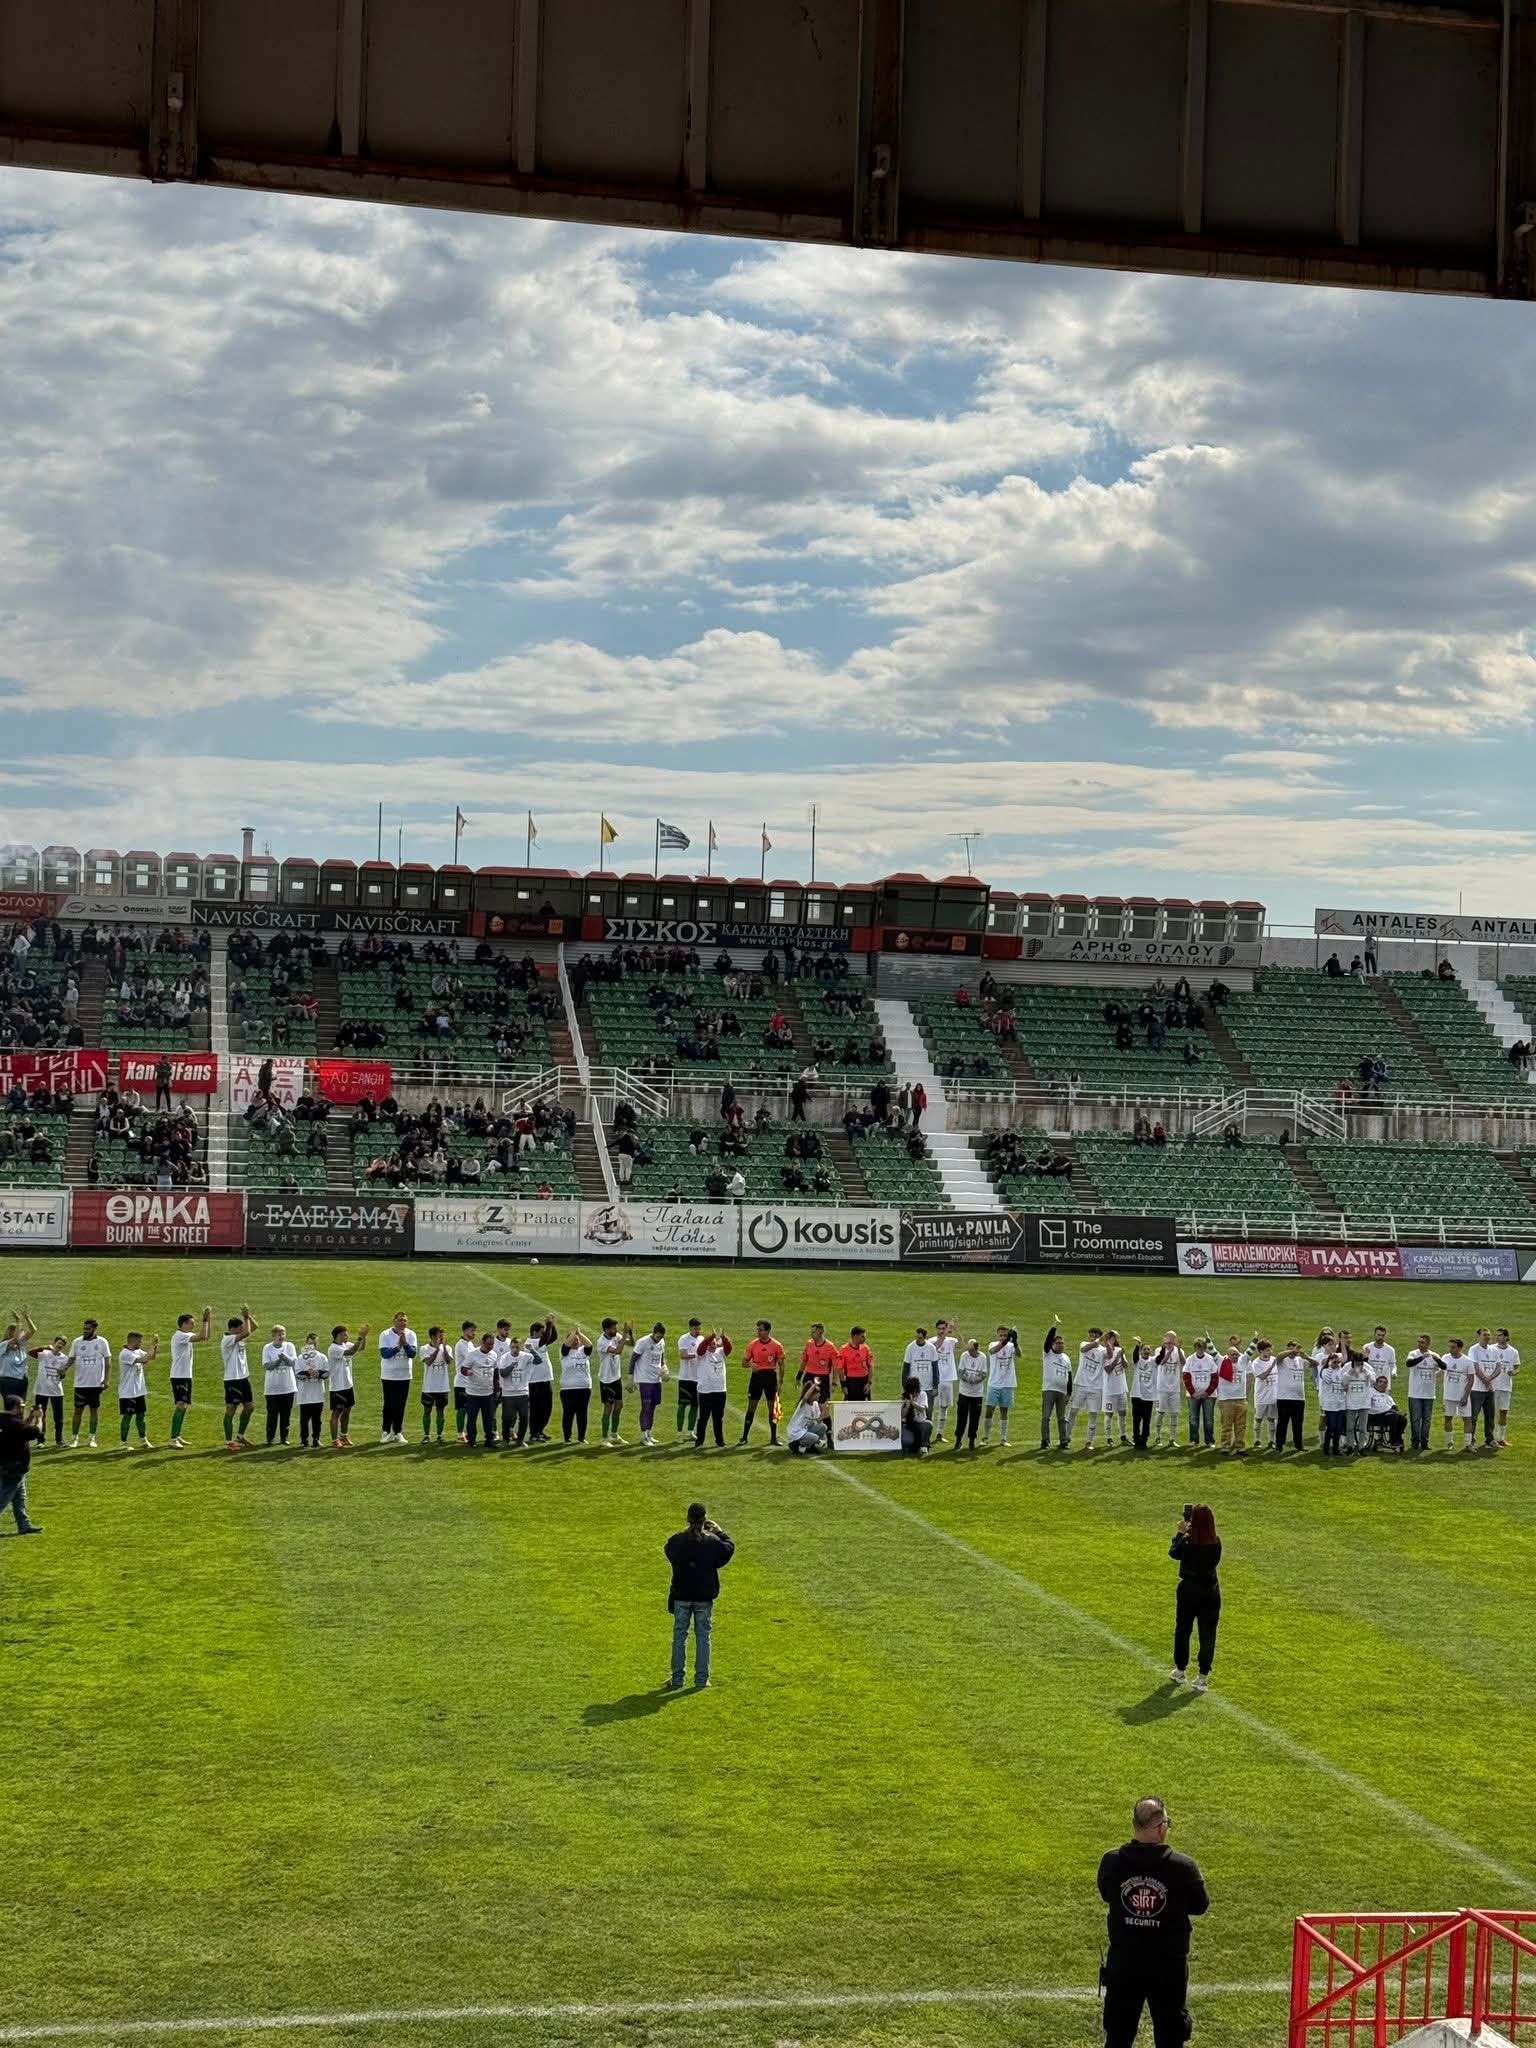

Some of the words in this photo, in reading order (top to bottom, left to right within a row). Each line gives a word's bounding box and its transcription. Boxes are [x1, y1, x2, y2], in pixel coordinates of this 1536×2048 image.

[193, 907, 320, 928] NAVISCRAFT
[335, 913, 460, 934] NAVISCRAFT
[1353, 914, 1437, 930] ANTALES
[605, 918, 717, 943] ΣΙΣΚΟΣ
[721, 923, 848, 940] ΚΑΤΑΣΚΕΥΑΣΤΙΚΗ
[1471, 919, 1536, 935] ANTAL
[1072, 941, 1132, 952] ΑΡΗΦ
[1145, 943, 1213, 956] ΟΓΛΟΥ
[1070, 951, 1213, 965] ΚΑΤΑΣΚΕΥΑΣΤΙΚΗ
[125, 1061, 212, 1080] XaniFans
[0, 1211, 56, 1224] STATE
[265, 1204, 408, 1232] ΕΔΕΣΜΑ
[422, 1210, 467, 1222] Hotel
[486, 1206, 504, 1223] Z
[523, 1212, 575, 1225] Palace
[643, 1206, 725, 1225] Παλαιά
[106, 1226, 143, 1242] BURN
[148, 1226, 160, 1235] THE
[163, 1226, 210, 1243] STREET
[794, 1217, 894, 1245] kousis
[915, 1219, 1011, 1238] TELIA+PAVLA
[1072, 1220, 1102, 1234] The
[465, 1238, 503, 1248] Congress
[505, 1238, 531, 1247] Center
[919, 1236, 1010, 1249] printing/sign/t-shirt
[1073, 1237, 1163, 1251] roommates
[1071, 1251, 1104, 1259] Construct
[1214, 1245, 1297, 1262] ΜΕΤΑΛΛΕΜΠΟΡΙΚΗ
[1311, 1250, 1399, 1266] ΠΛΑΤΗΣ
[1323, 1266, 1391, 1275] ΧΟΙΡΙΝΑ
[1132, 1894, 1157, 1909] SIRT
[1125, 1917, 1160, 1928] SECURITY
